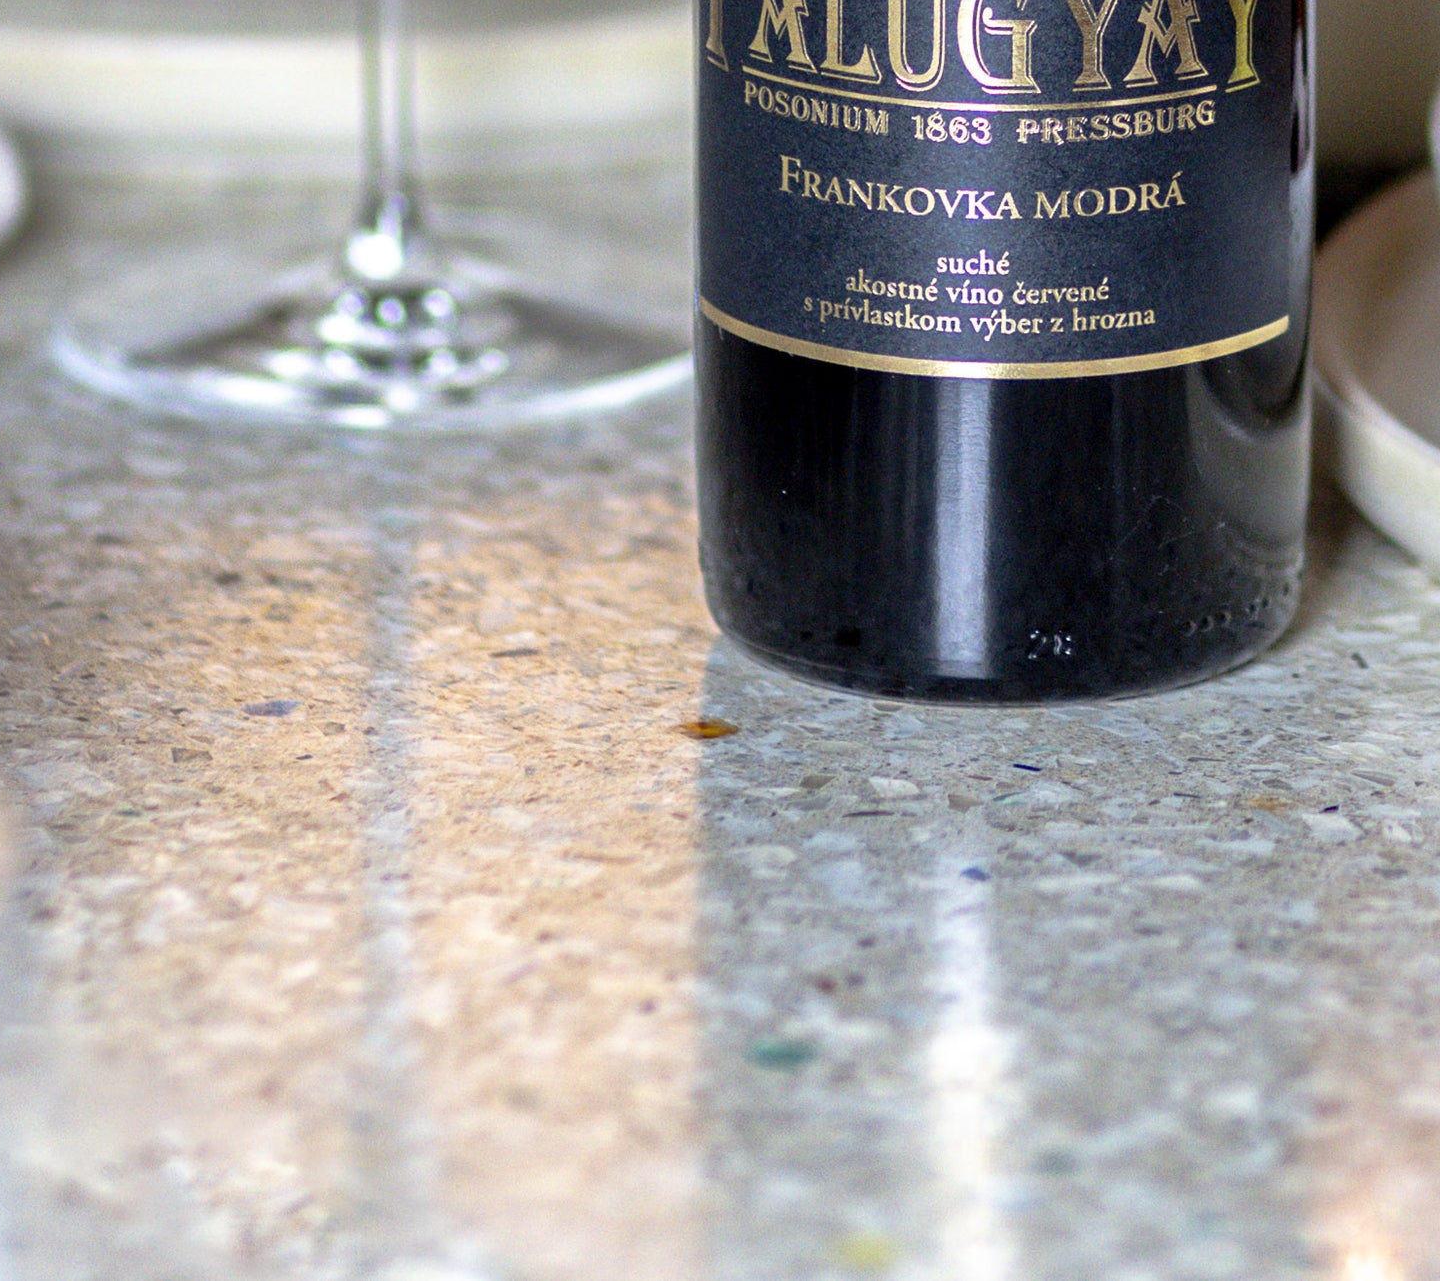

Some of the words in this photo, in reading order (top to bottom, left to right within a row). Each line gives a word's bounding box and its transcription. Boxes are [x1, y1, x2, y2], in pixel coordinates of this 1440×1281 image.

[743, 80, 889, 136] POSONIUM
[912, 111, 992, 145] 1863
[1016, 100, 1216, 145] PRESSBURG
[936, 250, 1010, 276] suché
[845, 268, 939, 301] akostné
[945, 279, 1004, 305] víno
[1012, 276, 1110, 305] červené
[803, 295, 813, 312] s
[819, 297, 962, 332] prívlastkom
[969, 309, 1043, 341] výber
[1050, 316, 1064, 332] z
[1072, 307, 1156, 332] hrozna
